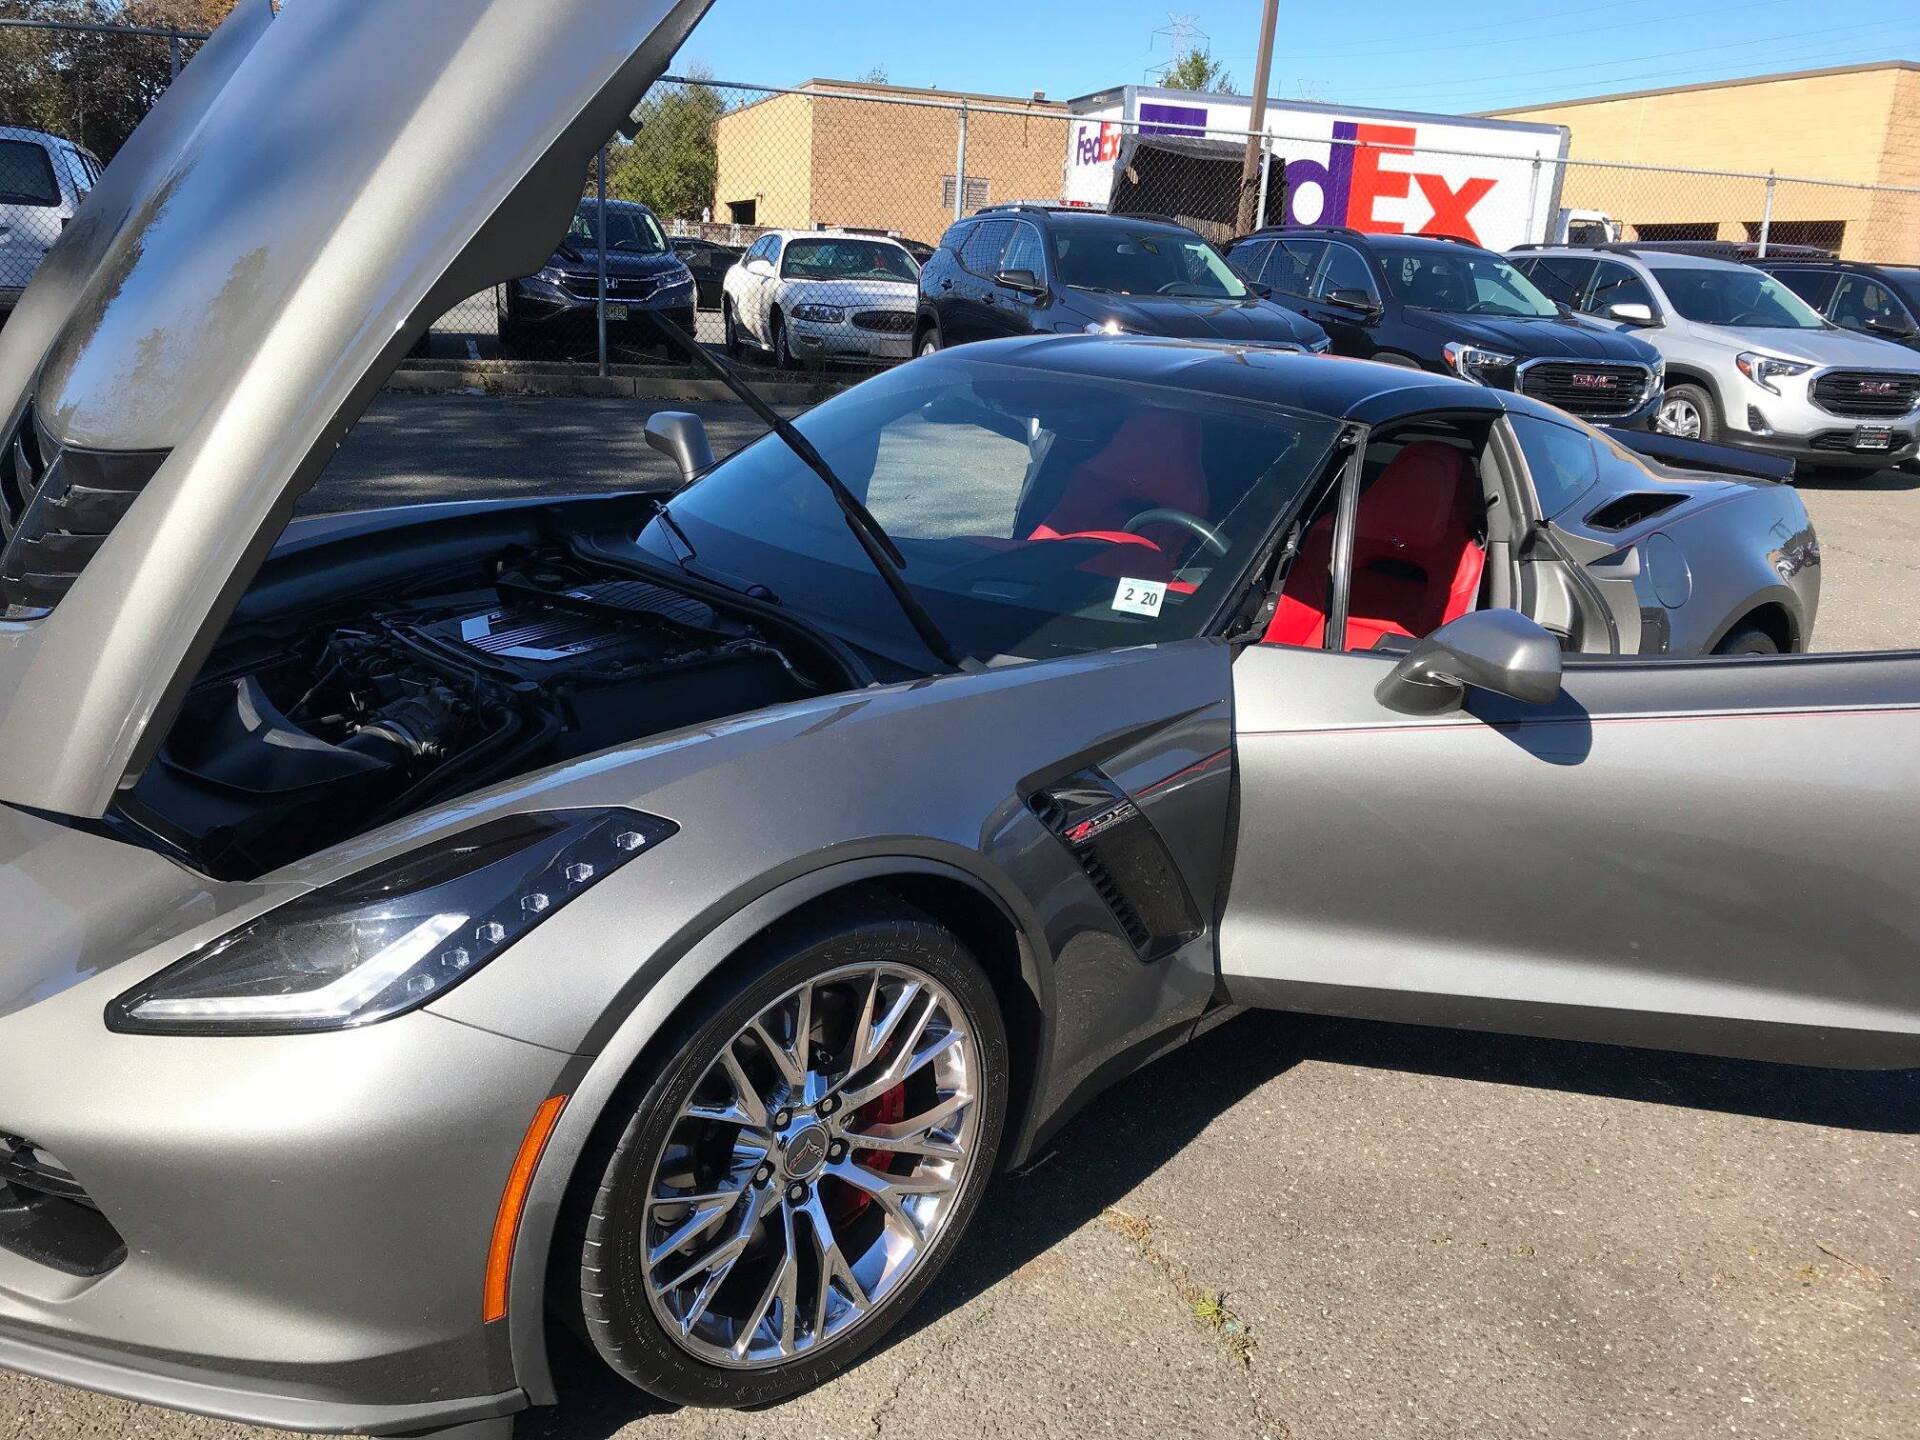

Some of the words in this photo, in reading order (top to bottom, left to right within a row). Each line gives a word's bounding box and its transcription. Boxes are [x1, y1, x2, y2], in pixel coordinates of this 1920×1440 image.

[1076, 120, 1122, 166] FedEx
[1124, 588, 1135, 601] 2
[1140, 592, 1158, 606] 20
